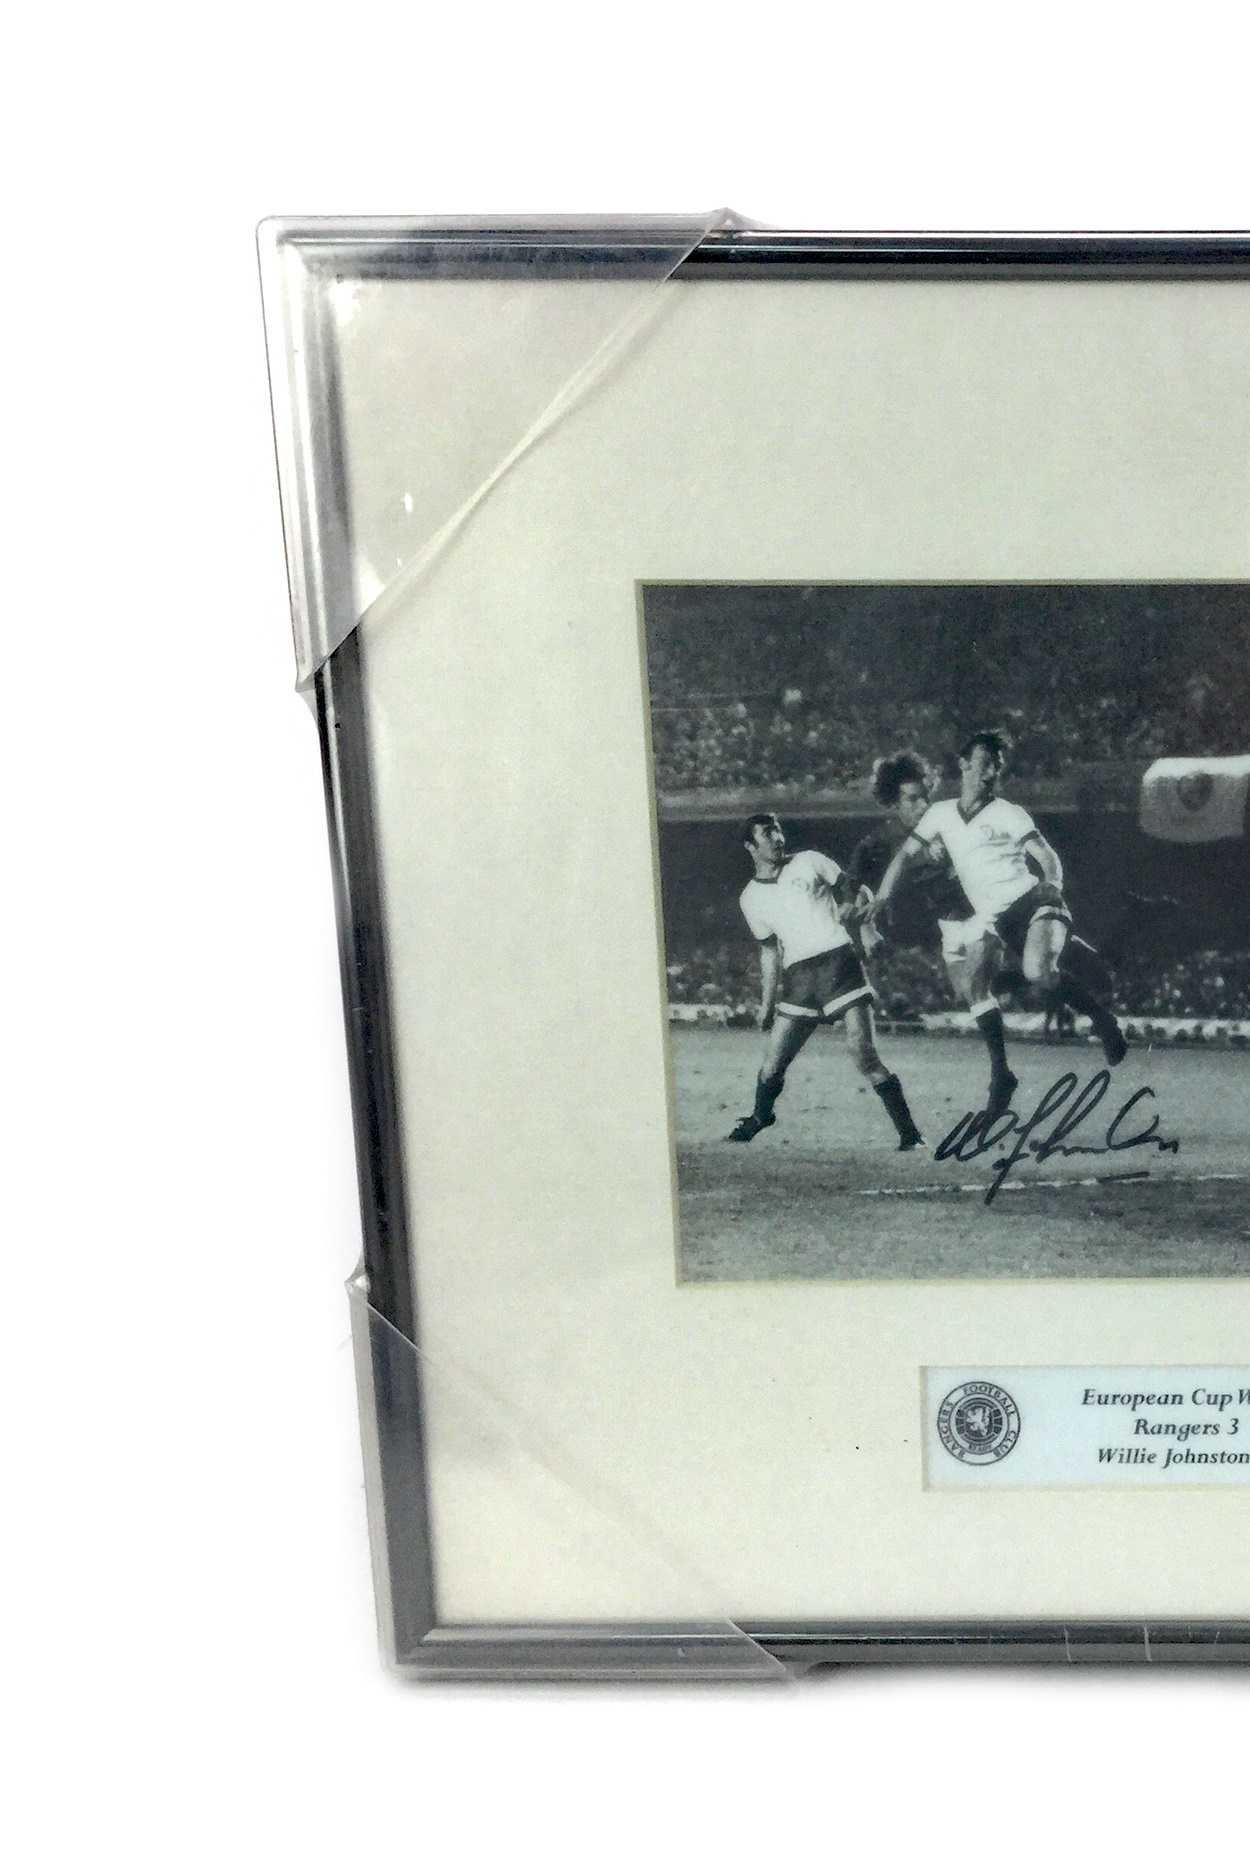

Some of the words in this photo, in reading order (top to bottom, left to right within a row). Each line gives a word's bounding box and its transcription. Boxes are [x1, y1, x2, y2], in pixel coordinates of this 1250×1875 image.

[1081, 1388, 1184, 1412] European
[1191, 1388, 1233, 1412] Cup
[1133, 1417, 1220, 1442] Rangers
[1227, 1417, 1239, 1436] 3
[1098, 1447, 1157, 1464] Willie
[1162, 1448, 1250, 1469] Johnston
